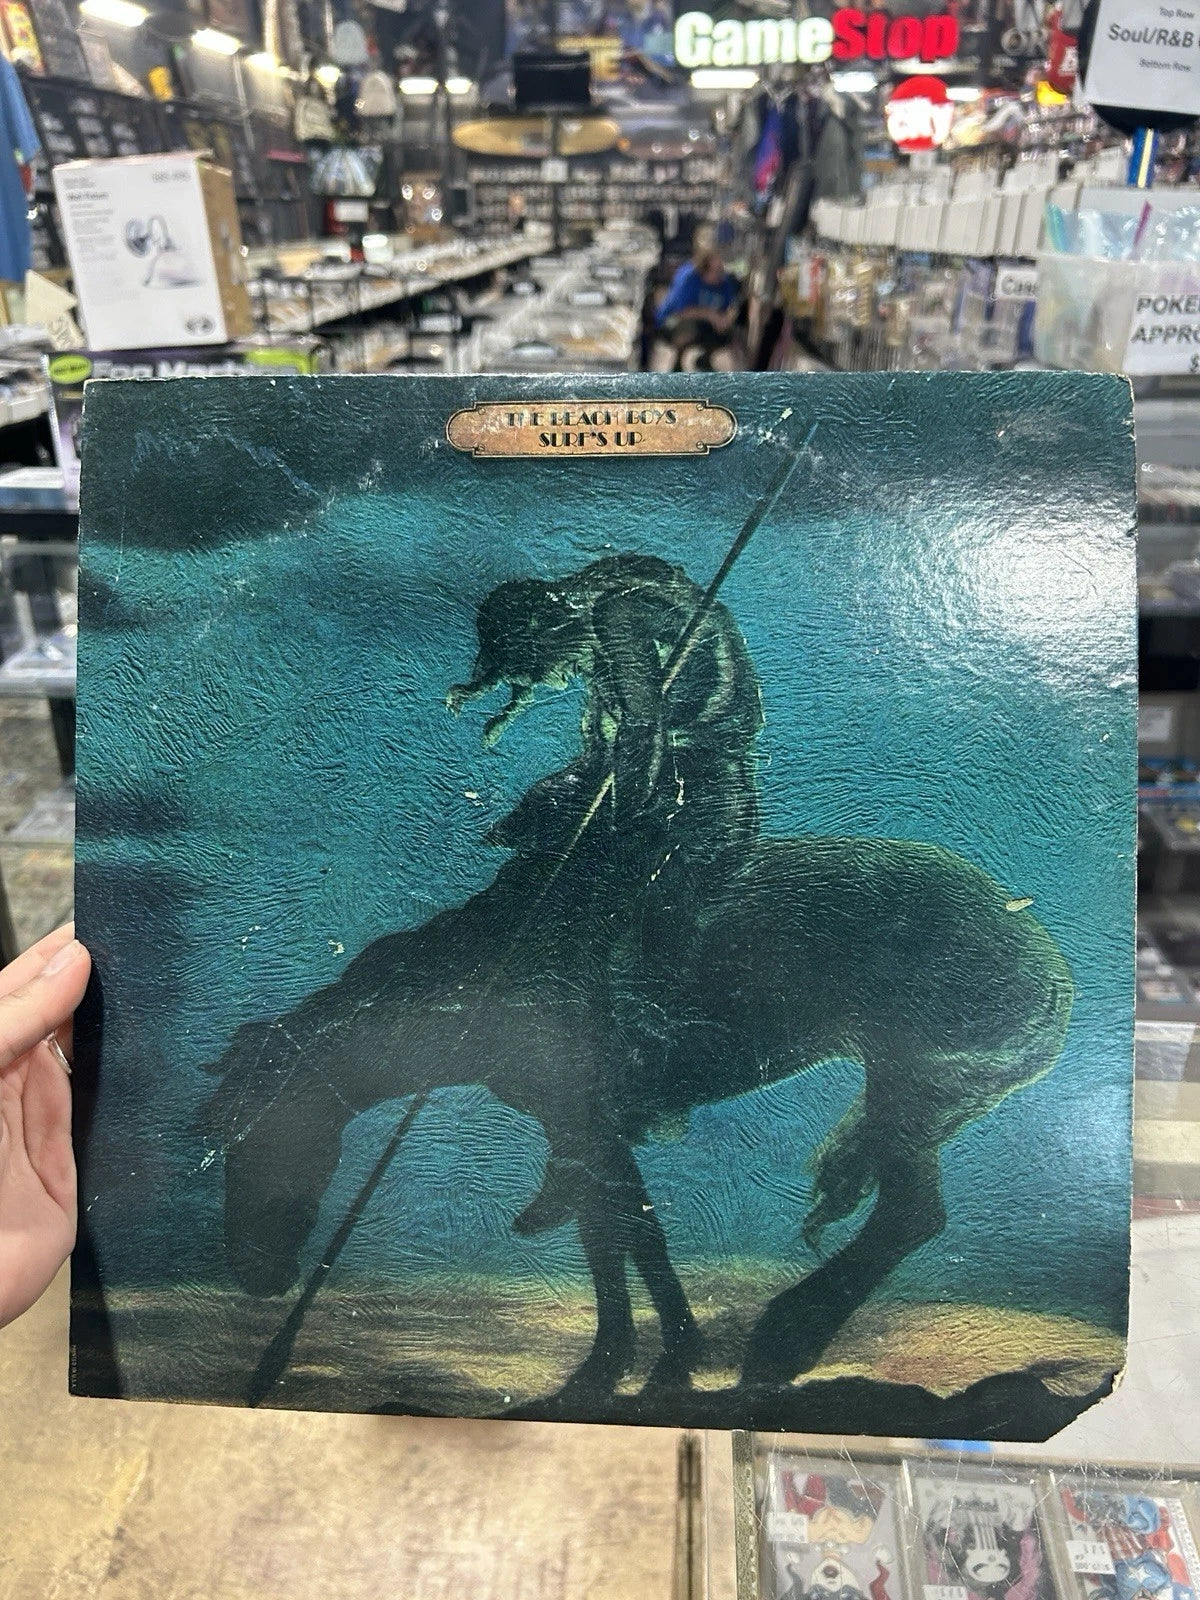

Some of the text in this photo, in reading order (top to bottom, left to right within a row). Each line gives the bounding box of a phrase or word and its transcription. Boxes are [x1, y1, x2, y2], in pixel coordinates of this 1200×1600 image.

[1159, 6, 1195, 19] Top Row
[675, 9, 959, 68] GameStop
[1108, 23, 1195, 48] Soul/R&B
[1173, 61, 1192, 73] Row
[1136, 294, 1200, 315] POKE
[505, 409, 677, 427] THE BEACH BOYS
[538, 431, 642, 447] SURF'S UP
